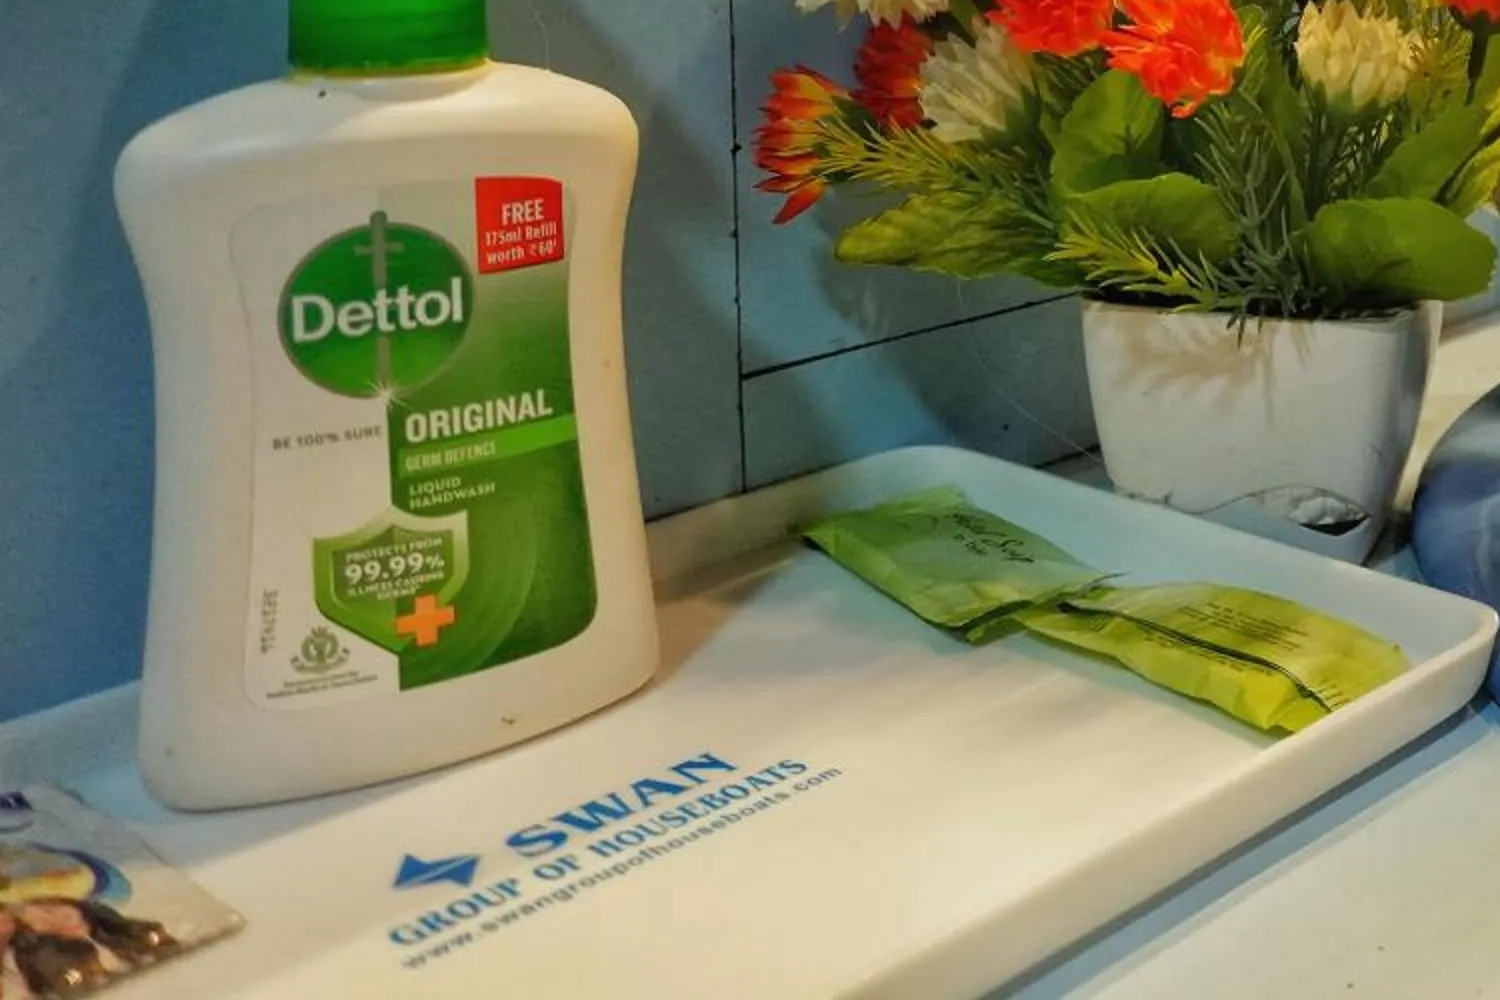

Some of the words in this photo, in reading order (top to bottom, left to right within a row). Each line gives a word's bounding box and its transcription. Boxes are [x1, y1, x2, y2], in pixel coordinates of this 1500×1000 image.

[502, 198, 544, 226] FREE
[486, 245, 525, 264] worth
[291, 276, 463, 343] Dettol
[405, 388, 553, 443] ORIGINAL
[405, 452, 442, 472] GERM
[444, 440, 496, 465] DEFENCE
[409, 476, 462, 497] LIQUID
[409, 482, 496, 510] HANDWASH
[408, 537, 443, 550] FROM
[344, 551, 445, 584] 99.99%
[505, 752, 738, 858] SWAN
[388, 876, 521, 946] GROUP
[532, 853, 581, 881] OF
[587, 758, 809, 858] HOUSEBOATS
